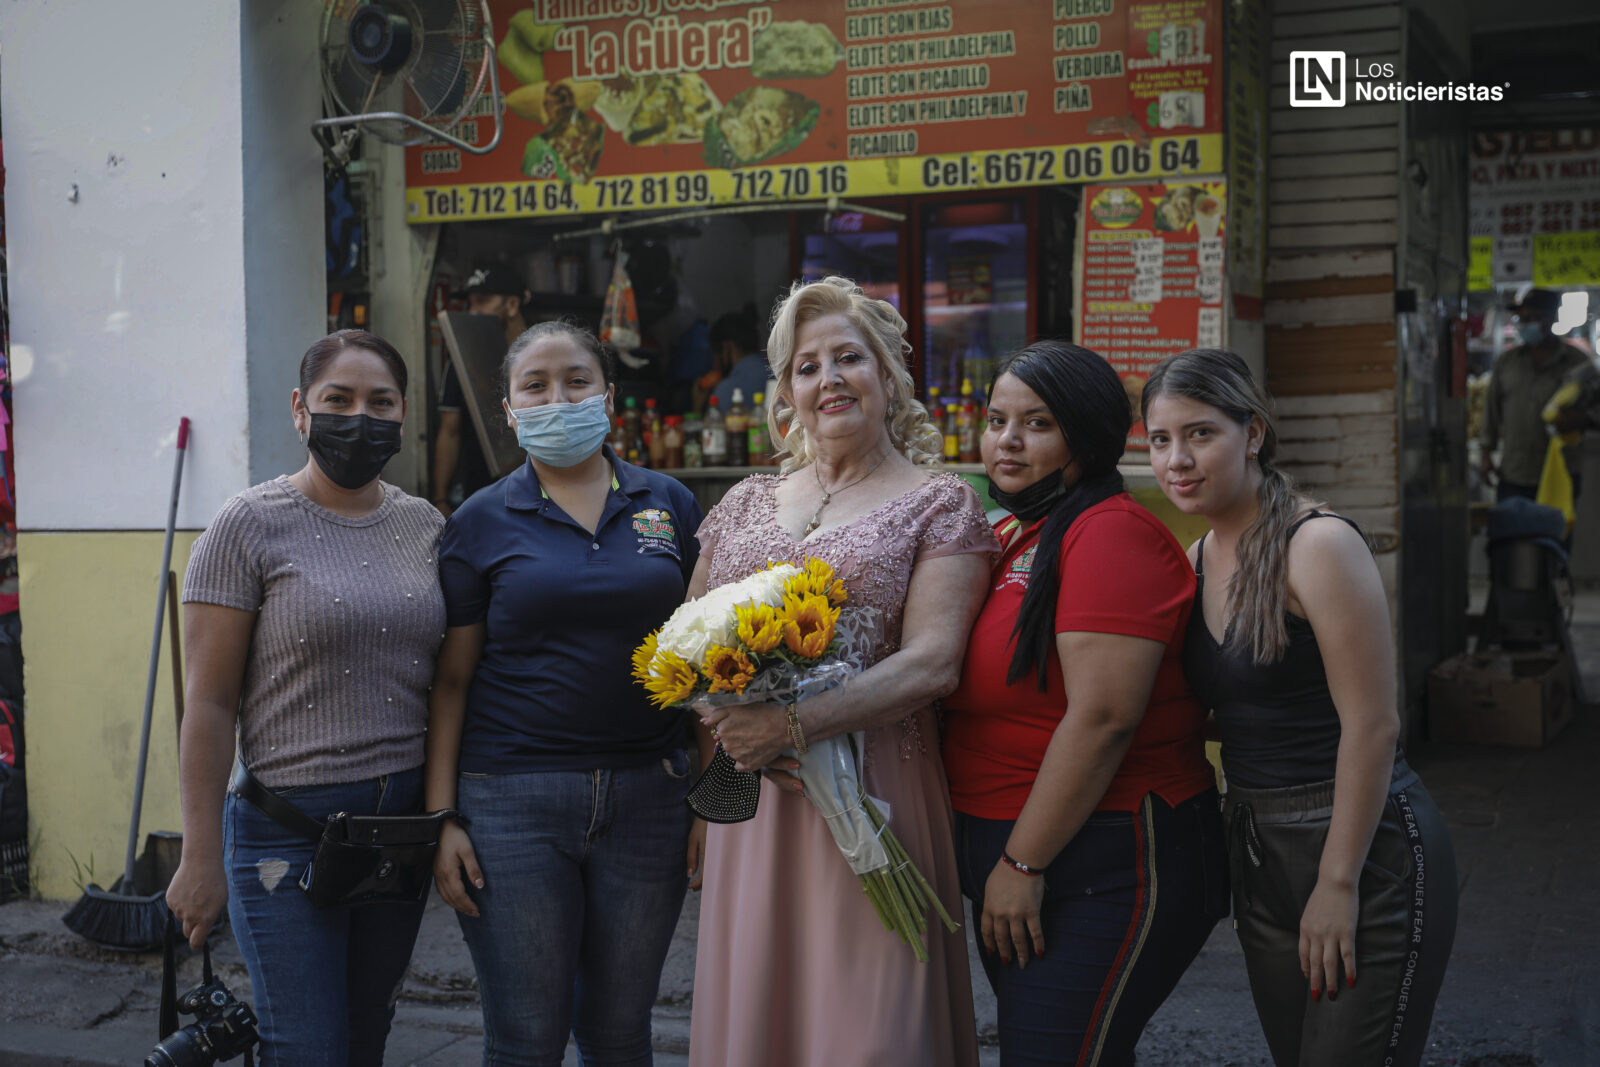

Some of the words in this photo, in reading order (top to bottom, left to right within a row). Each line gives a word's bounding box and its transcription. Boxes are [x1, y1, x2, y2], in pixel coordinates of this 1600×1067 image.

[847, 15, 885, 40] ELOTE
[887, 11, 915, 36] CON
[1055, 23, 1099, 49] POLLO
[847, 44, 885, 69] ELOTE
[887, 41, 915, 65] CON
[918, 31, 1015, 63] PHILADELPHIA
[1055, 52, 1124, 80] VERDURA
[847, 74, 885, 98] ELOTE
[887, 71, 915, 95] CON
[918, 65, 989, 93] PICADILLO
[848, 104, 885, 128] ELOTE
[888, 101, 916, 125] CON
[918, 93, 1015, 123] PHILADELPHIA
[1016, 91, 1027, 115] Y
[848, 131, 917, 157] PICADILLO
[922, 156, 977, 188] Cel:
[983, 150, 1056, 184] 6672
[1063, 147, 1103, 179] 06
[1111, 144, 1150, 175] 06
[1159, 138, 1200, 172] 64
[424, 188, 464, 216] Tel:
[469, 186, 506, 214] 712
[511, 184, 537, 212] 14
[594, 178, 634, 208] 712
[641, 176, 669, 205] 81
[731, 170, 774, 200] 712
[780, 167, 810, 197] 70
[816, 165, 848, 195] 16
[1402, 806, 1419, 839] FEAR
[1413, 844, 1425, 907] CONQUER
[1411, 909, 1424, 944] FEAR
[1397, 950, 1419, 1012] CONQUER
[1389, 1015, 1404, 1048] FEAR
